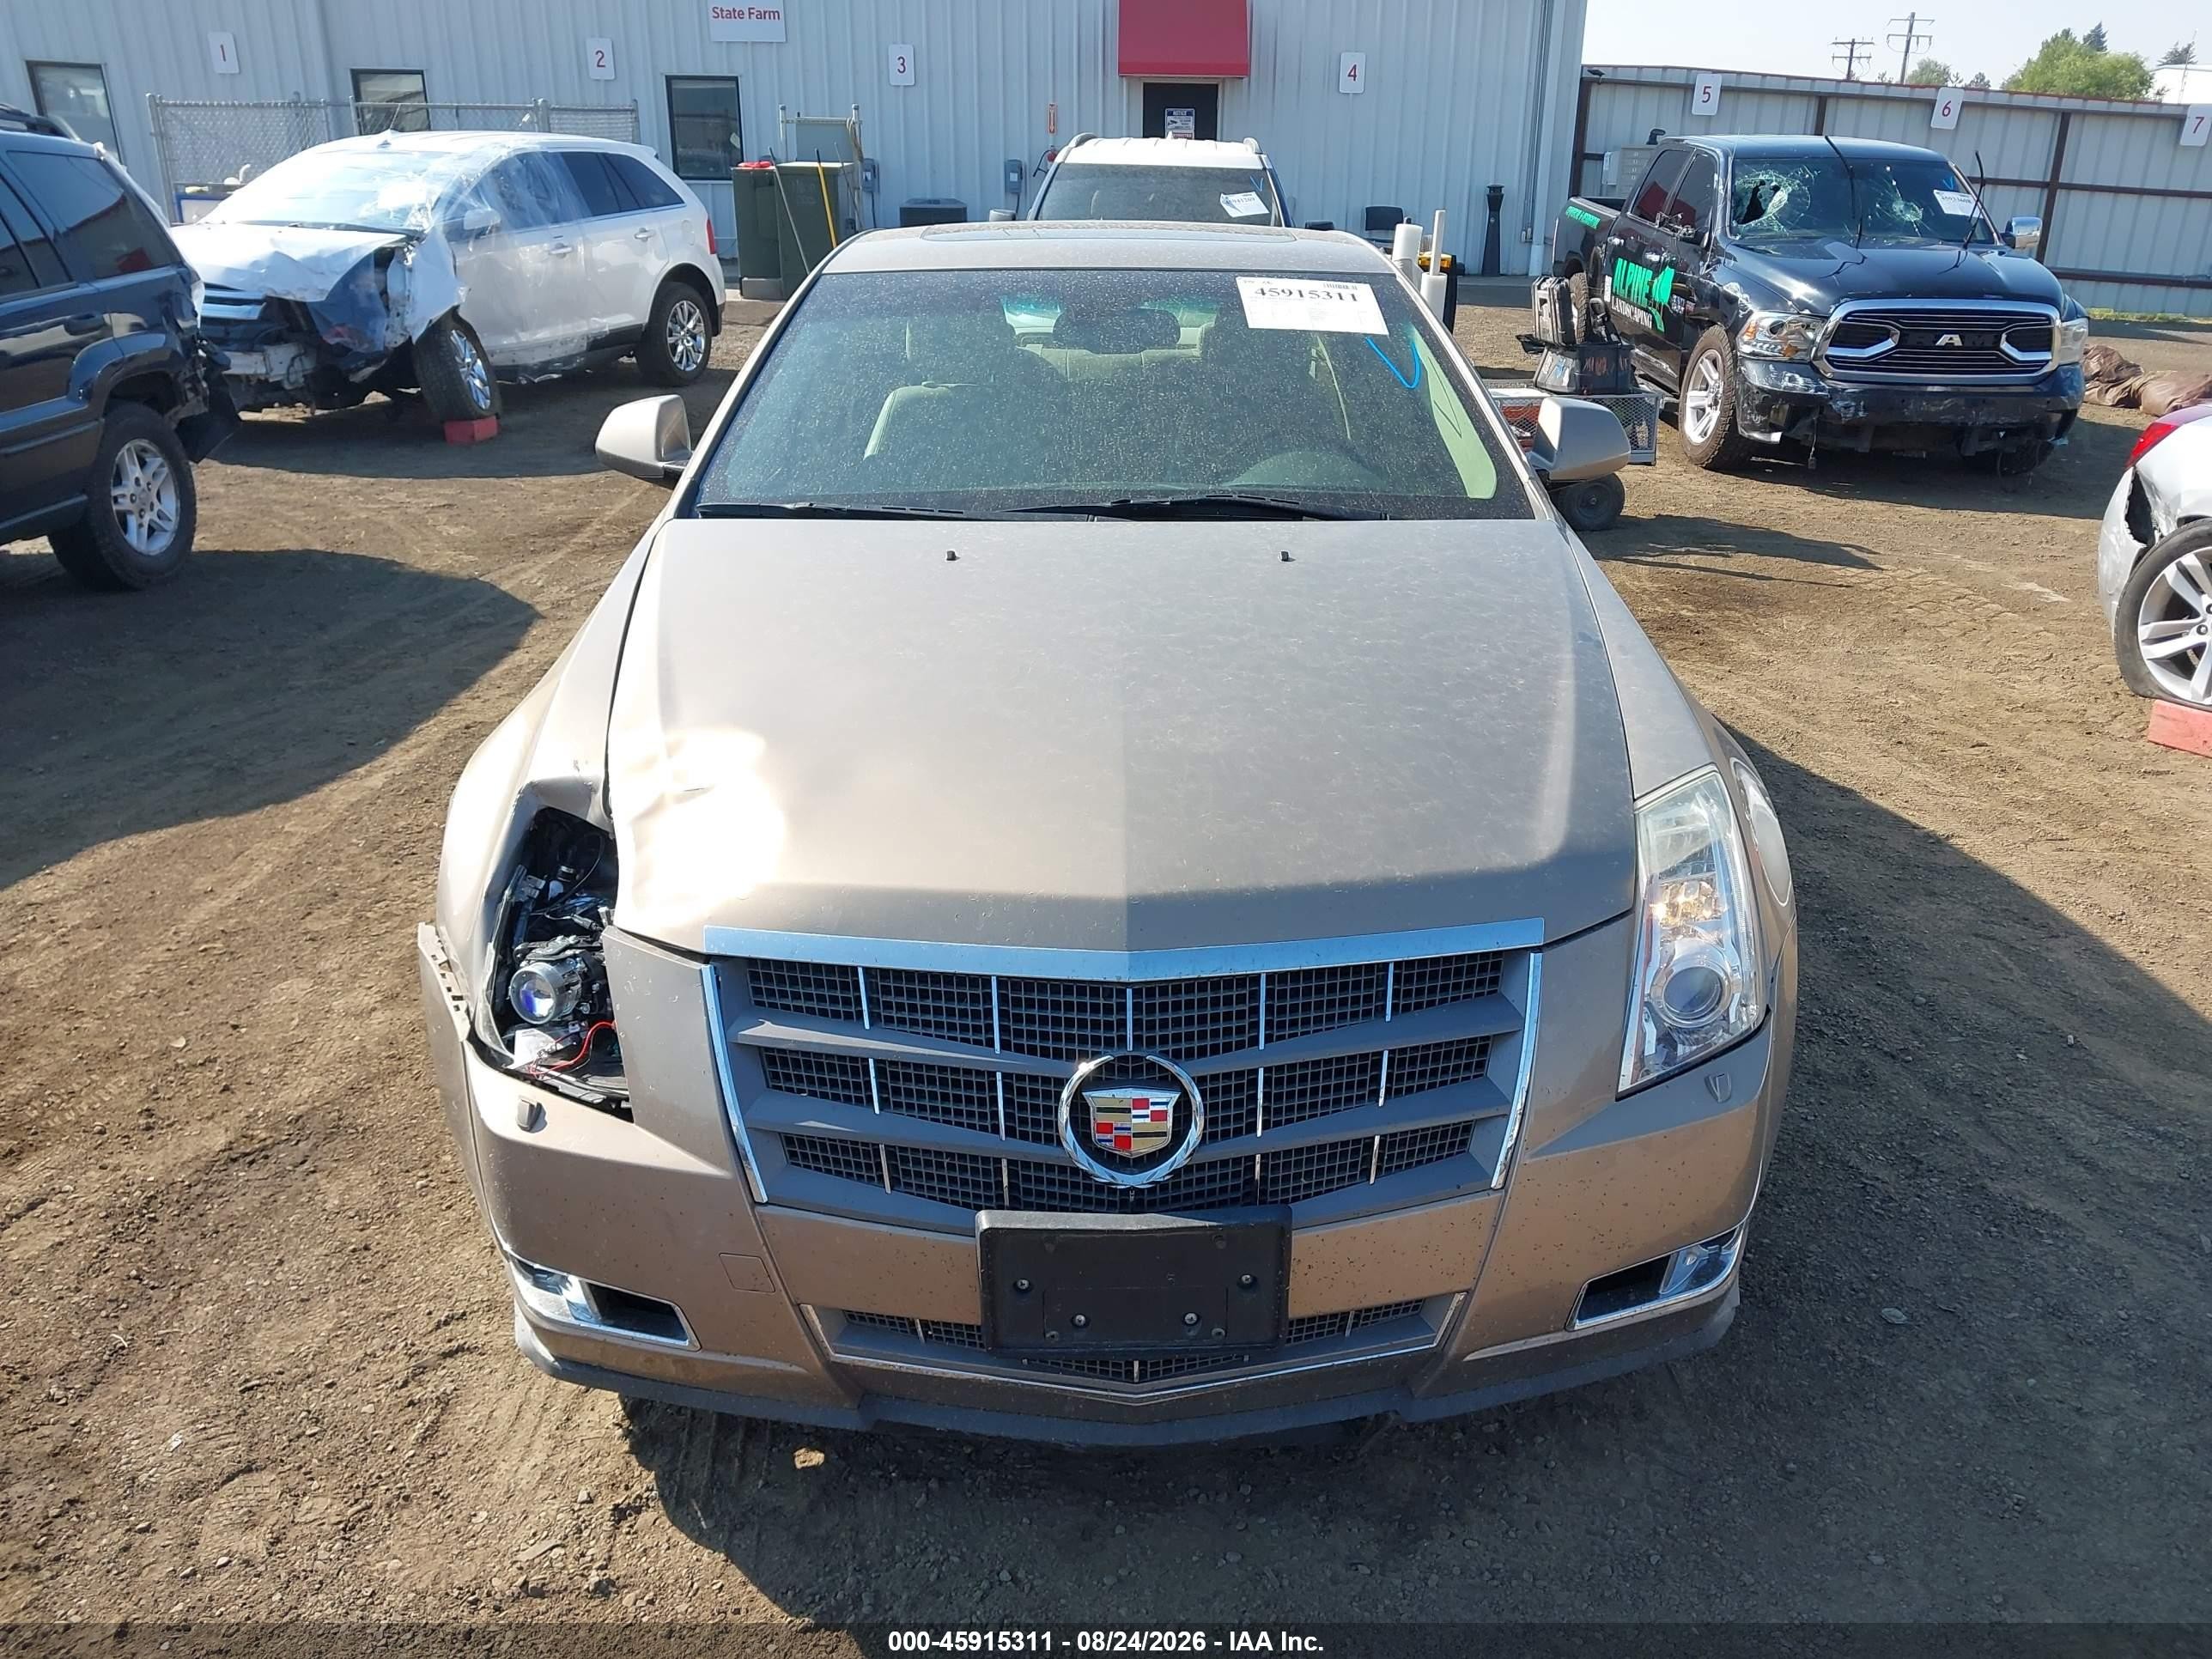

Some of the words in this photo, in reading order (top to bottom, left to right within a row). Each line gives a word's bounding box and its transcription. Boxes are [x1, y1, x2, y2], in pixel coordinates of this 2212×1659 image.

[712, 6, 744, 20] State
[748, 7, 781, 21] Farm
[220, 44, 227, 62] 1
[595, 50, 605, 68] 2
[896, 57, 907, 75] 3
[1347, 64, 1358, 82] 4
[1702, 85, 1712, 104] 5
[1942, 100, 1952, 118] 6
[2192, 116, 2205, 134] 7
[1613, 258, 1653, 309] ALPINE
[1255, 287, 1358, 301] 45915311
[1611, 295, 1653, 330] LANDSCAPING
